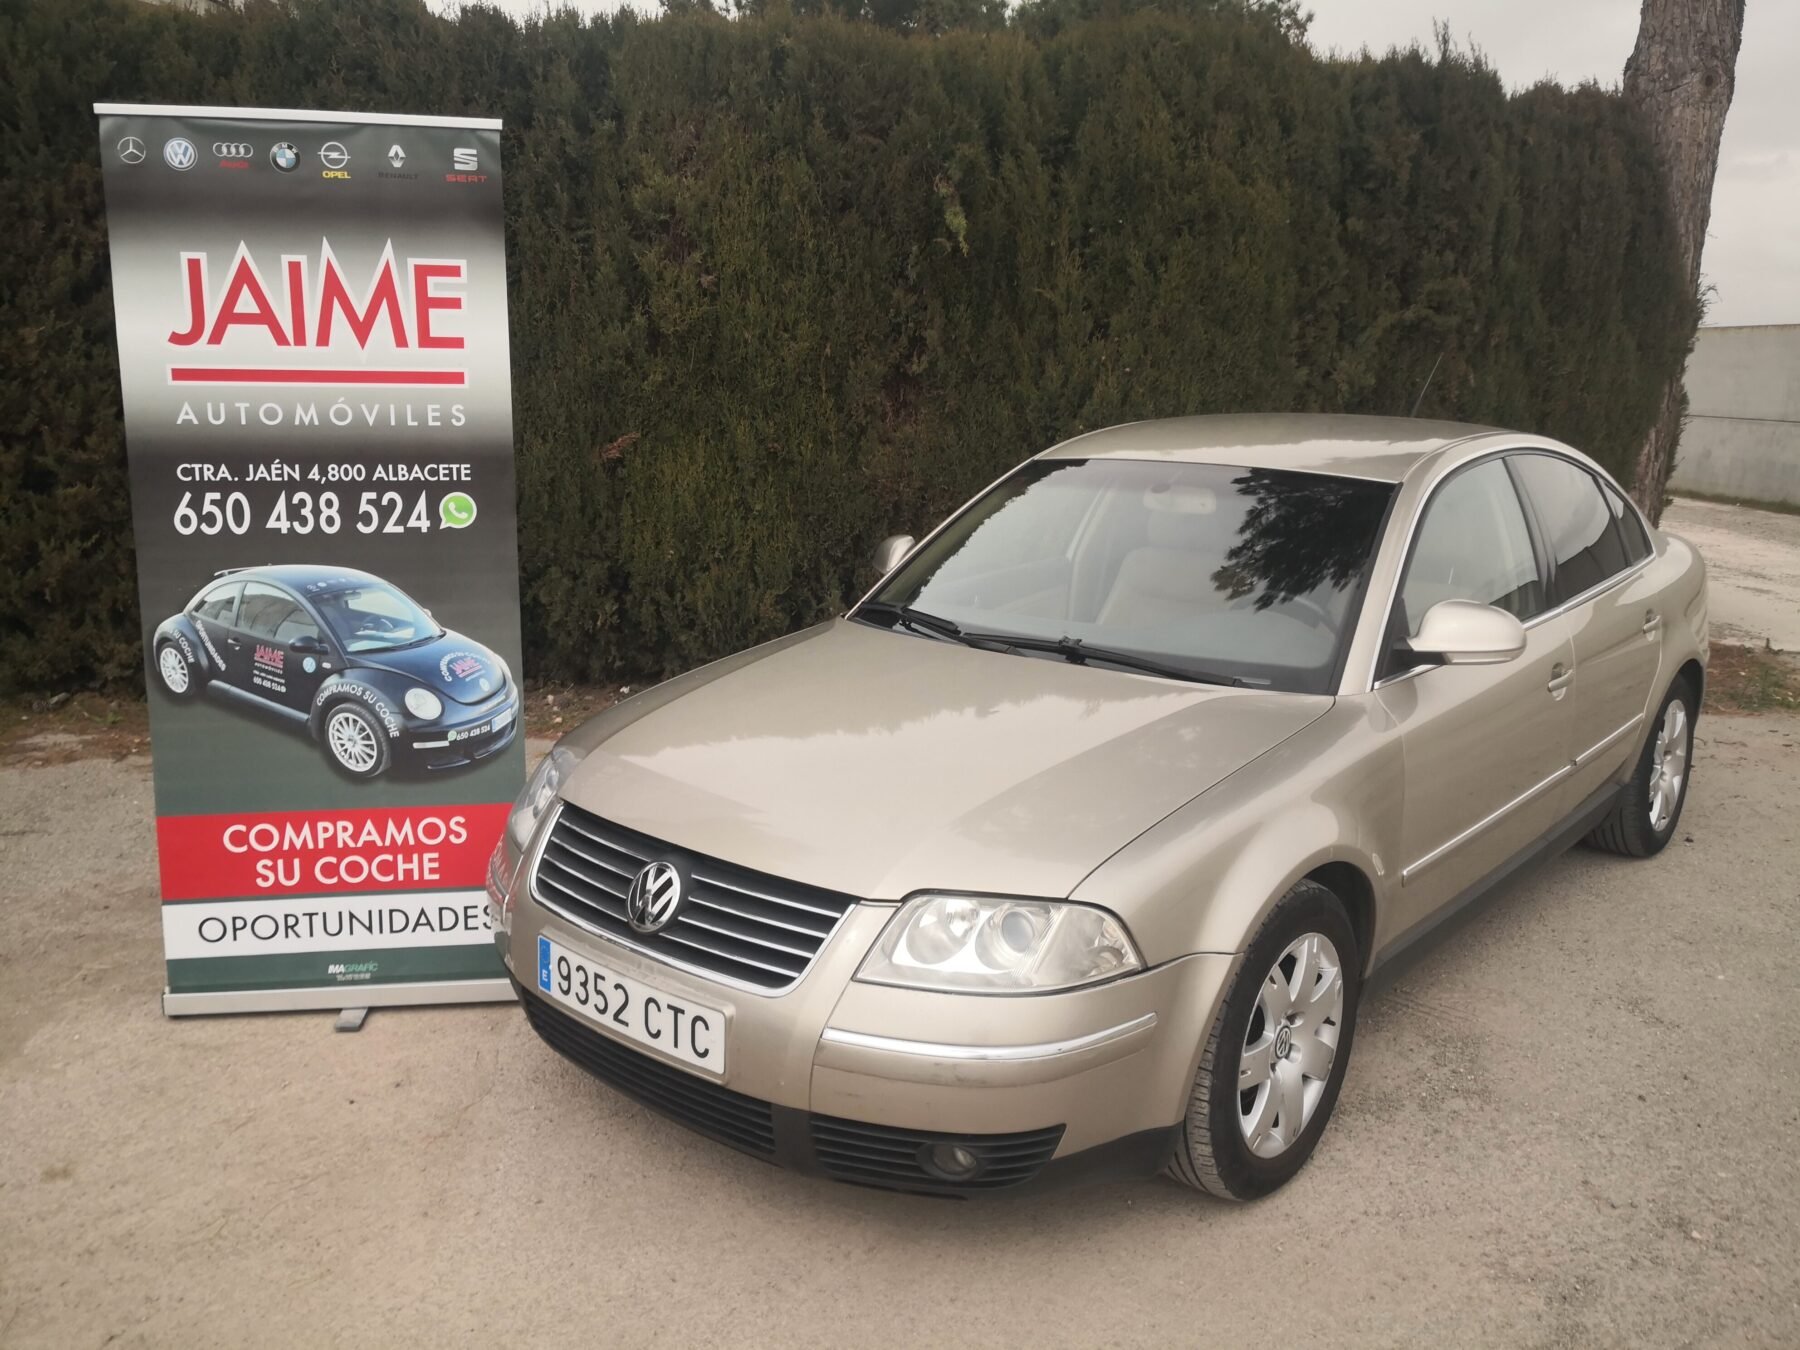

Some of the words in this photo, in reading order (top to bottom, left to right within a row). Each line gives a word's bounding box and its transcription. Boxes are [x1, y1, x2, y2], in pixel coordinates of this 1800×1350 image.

[322, 170, 351, 179] OPEL
[445, 174, 487, 183] SEAT
[167, 237, 468, 357] JAIME
[176, 397, 466, 427] AUTOMÓVILES
[176, 463, 239, 482] CTRA.
[245, 459, 301, 482] JAÉN
[307, 463, 366, 485] 4,800
[372, 463, 472, 482] ALBACETE
[173, 490, 251, 536] 650
[265, 489, 341, 535] 438
[356, 489, 431, 534] 524
[178, 637, 195, 664] COCHE
[316, 683, 363, 706] COMPRAMOS
[363, 691, 377, 704] SU
[375, 702, 400, 738] COCHE
[456, 731, 469, 741] 650
[223, 815, 468, 854] COMPRAMOS
[255, 858, 301, 888] SU
[314, 852, 440, 885] COCHE
[557, 956, 630, 1028] 9352
[643, 997, 711, 1060] CTC
